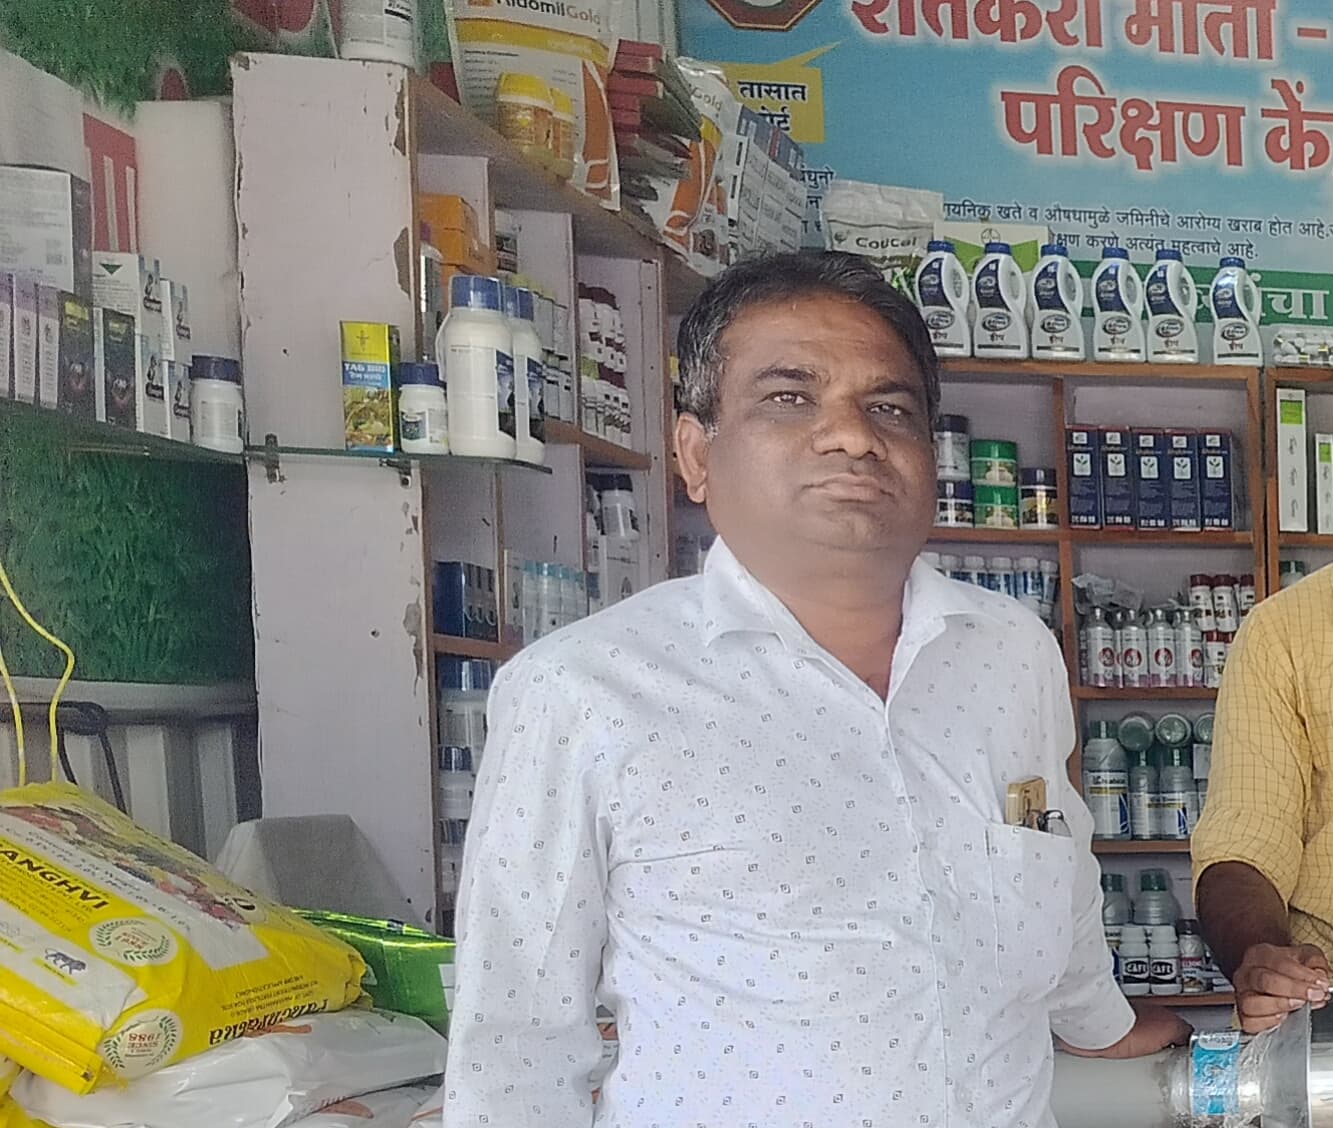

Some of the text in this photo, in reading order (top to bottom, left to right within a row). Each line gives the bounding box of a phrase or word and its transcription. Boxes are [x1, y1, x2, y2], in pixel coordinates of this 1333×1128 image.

[1001, 65, 1246, 171] परिक्षण
[996, 202, 1022, 221] खते
[1028, 206, 1039, 221] व
[1044, 205, 1110, 229] औषधामुळे
[1115, 207, 1170, 228] जमिनीचे
[1176, 213, 1223, 231] आरोग्य
[1227, 217, 1263, 235] खराब
[1268, 216, 1293, 237] होत
[1085, 231, 1119, 250] करणे
